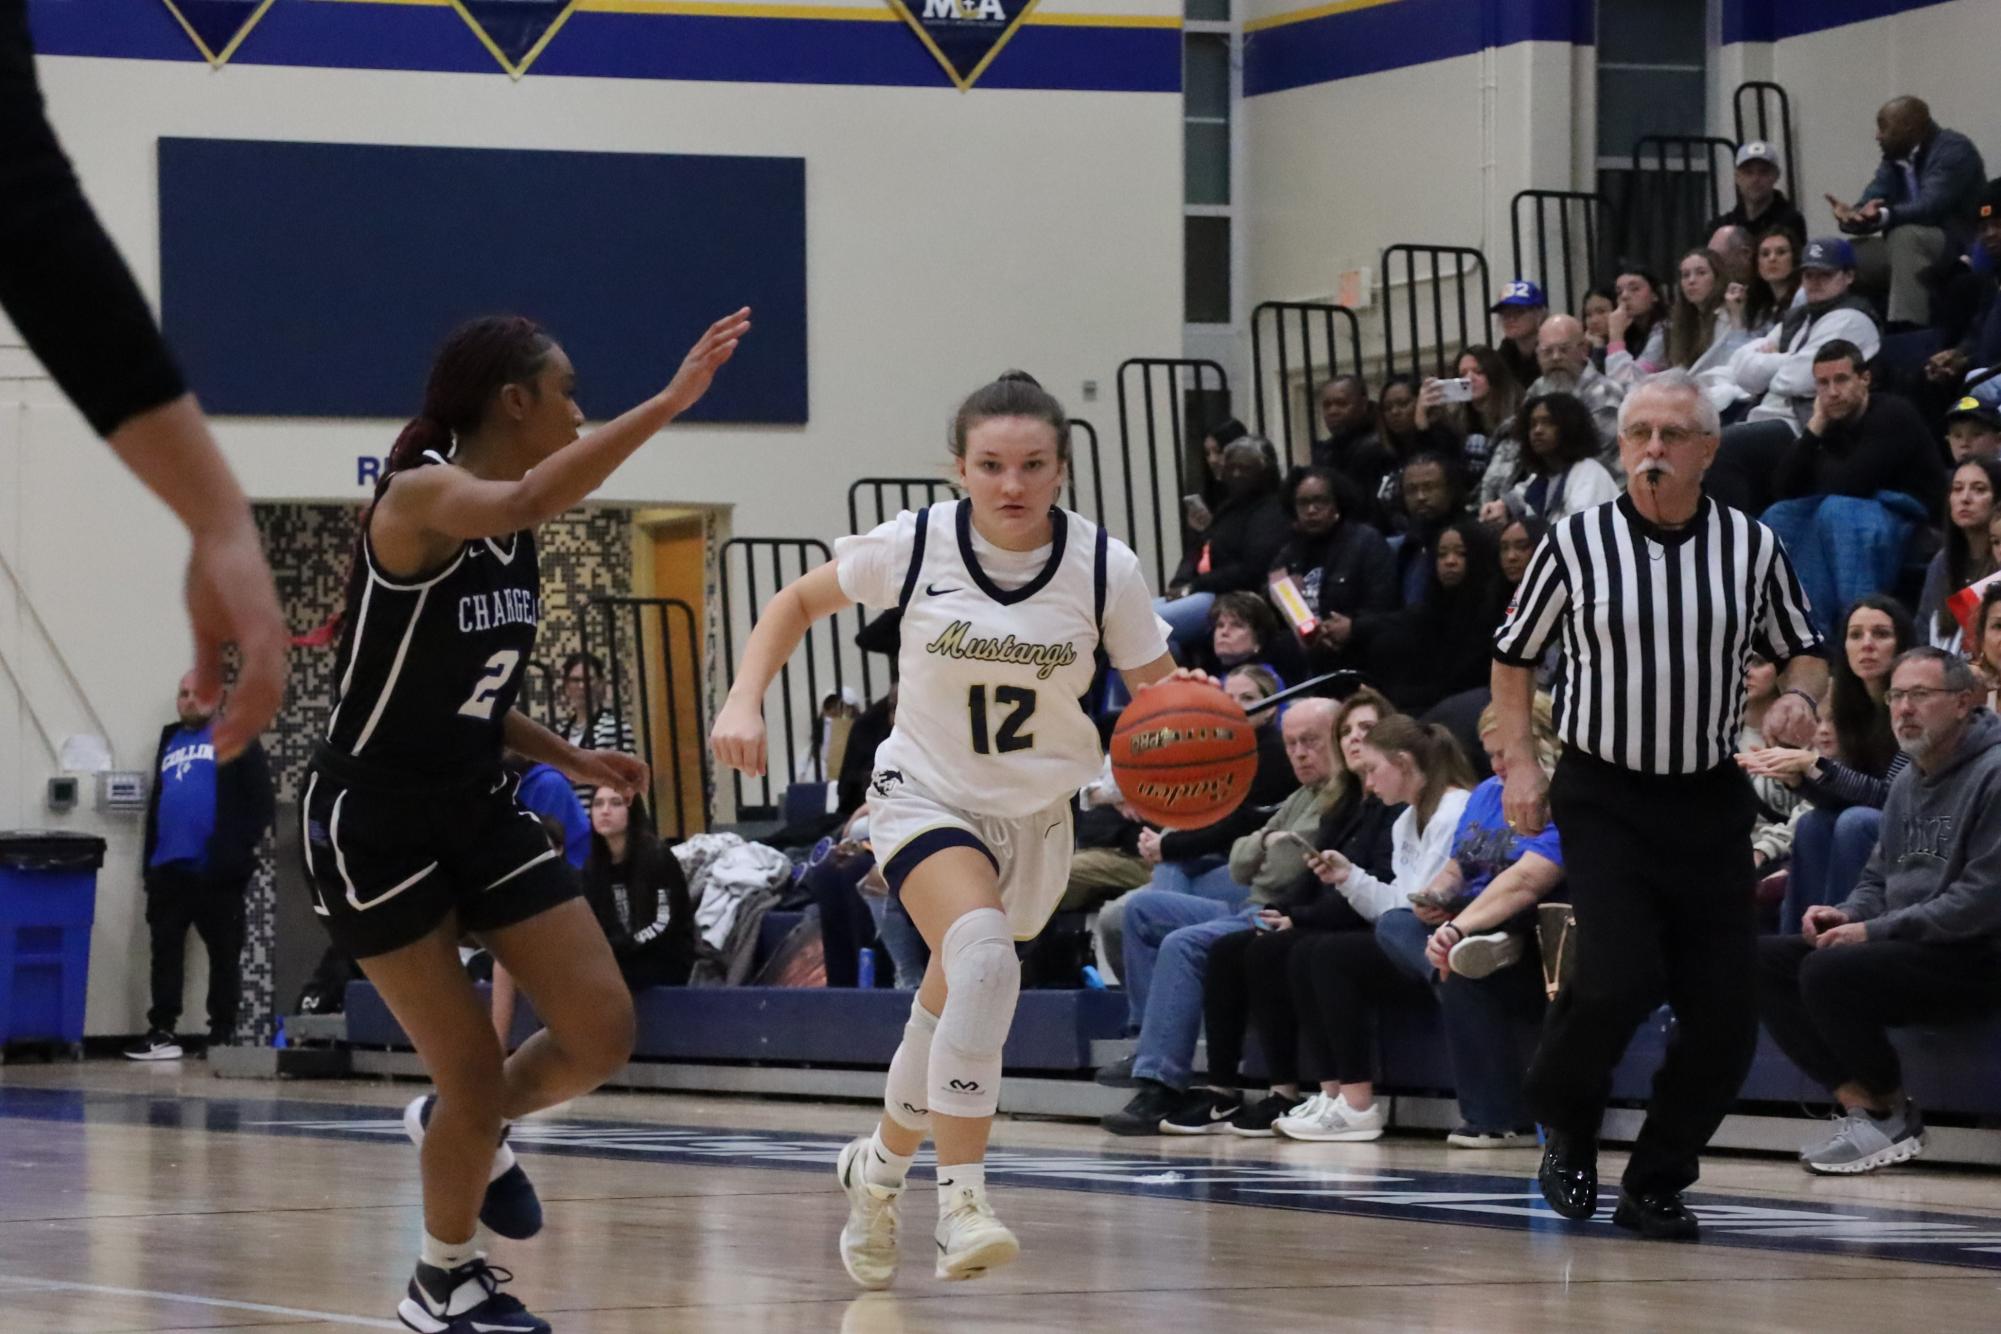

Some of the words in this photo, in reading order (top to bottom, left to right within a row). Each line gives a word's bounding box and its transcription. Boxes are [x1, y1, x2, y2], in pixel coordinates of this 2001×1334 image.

[456, 649, 520, 720] 2
[926, 619, 1078, 681] Mustangs
[967, 683, 1037, 755] 12
